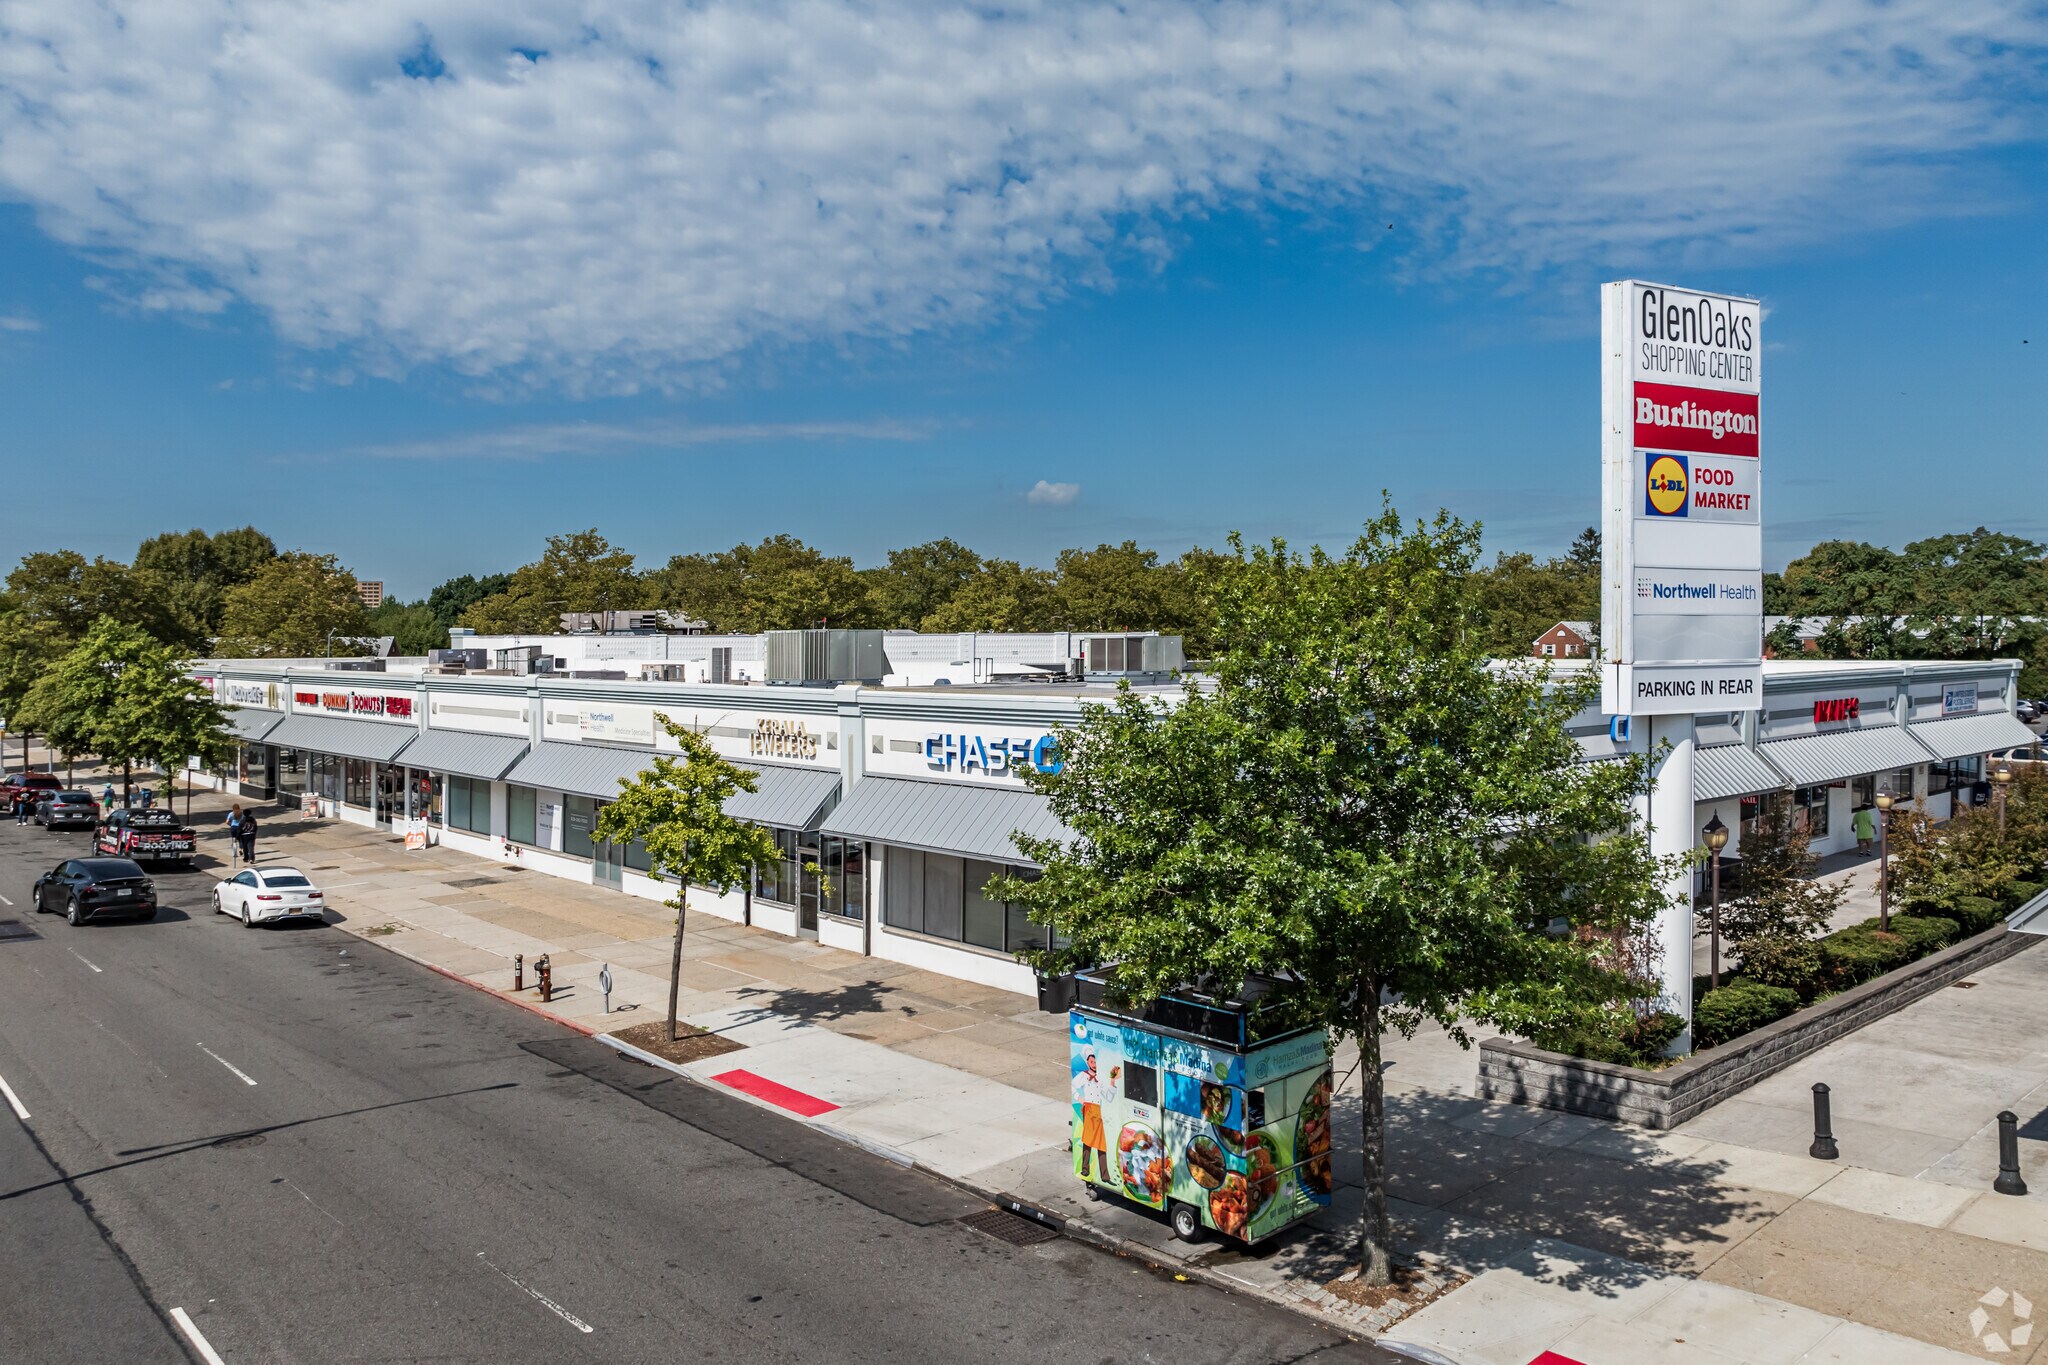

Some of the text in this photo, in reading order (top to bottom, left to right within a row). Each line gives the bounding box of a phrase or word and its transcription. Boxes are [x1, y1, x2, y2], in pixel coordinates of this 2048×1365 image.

[1642, 342, 1753, 383] SHOPPING CENTER
[1636, 397, 1757, 439] Burlington
[1694, 468, 1734, 486] FOOD
[1694, 491, 1751, 510] MARKET
[1653, 583, 1757, 600] Northwell Health
[1638, 679, 1753, 698] PARKING IN REAR
[354, 694, 381, 713] DONUTS
[589, 712, 614, 722] Northwell
[756, 718, 807, 737] KERALA
[748, 732, 817, 756] JEWELERS
[926, 732, 1032, 771] CHASE
[1742, 796, 1757, 804] NAIL
[143, 841, 190, 850] ROOFING
